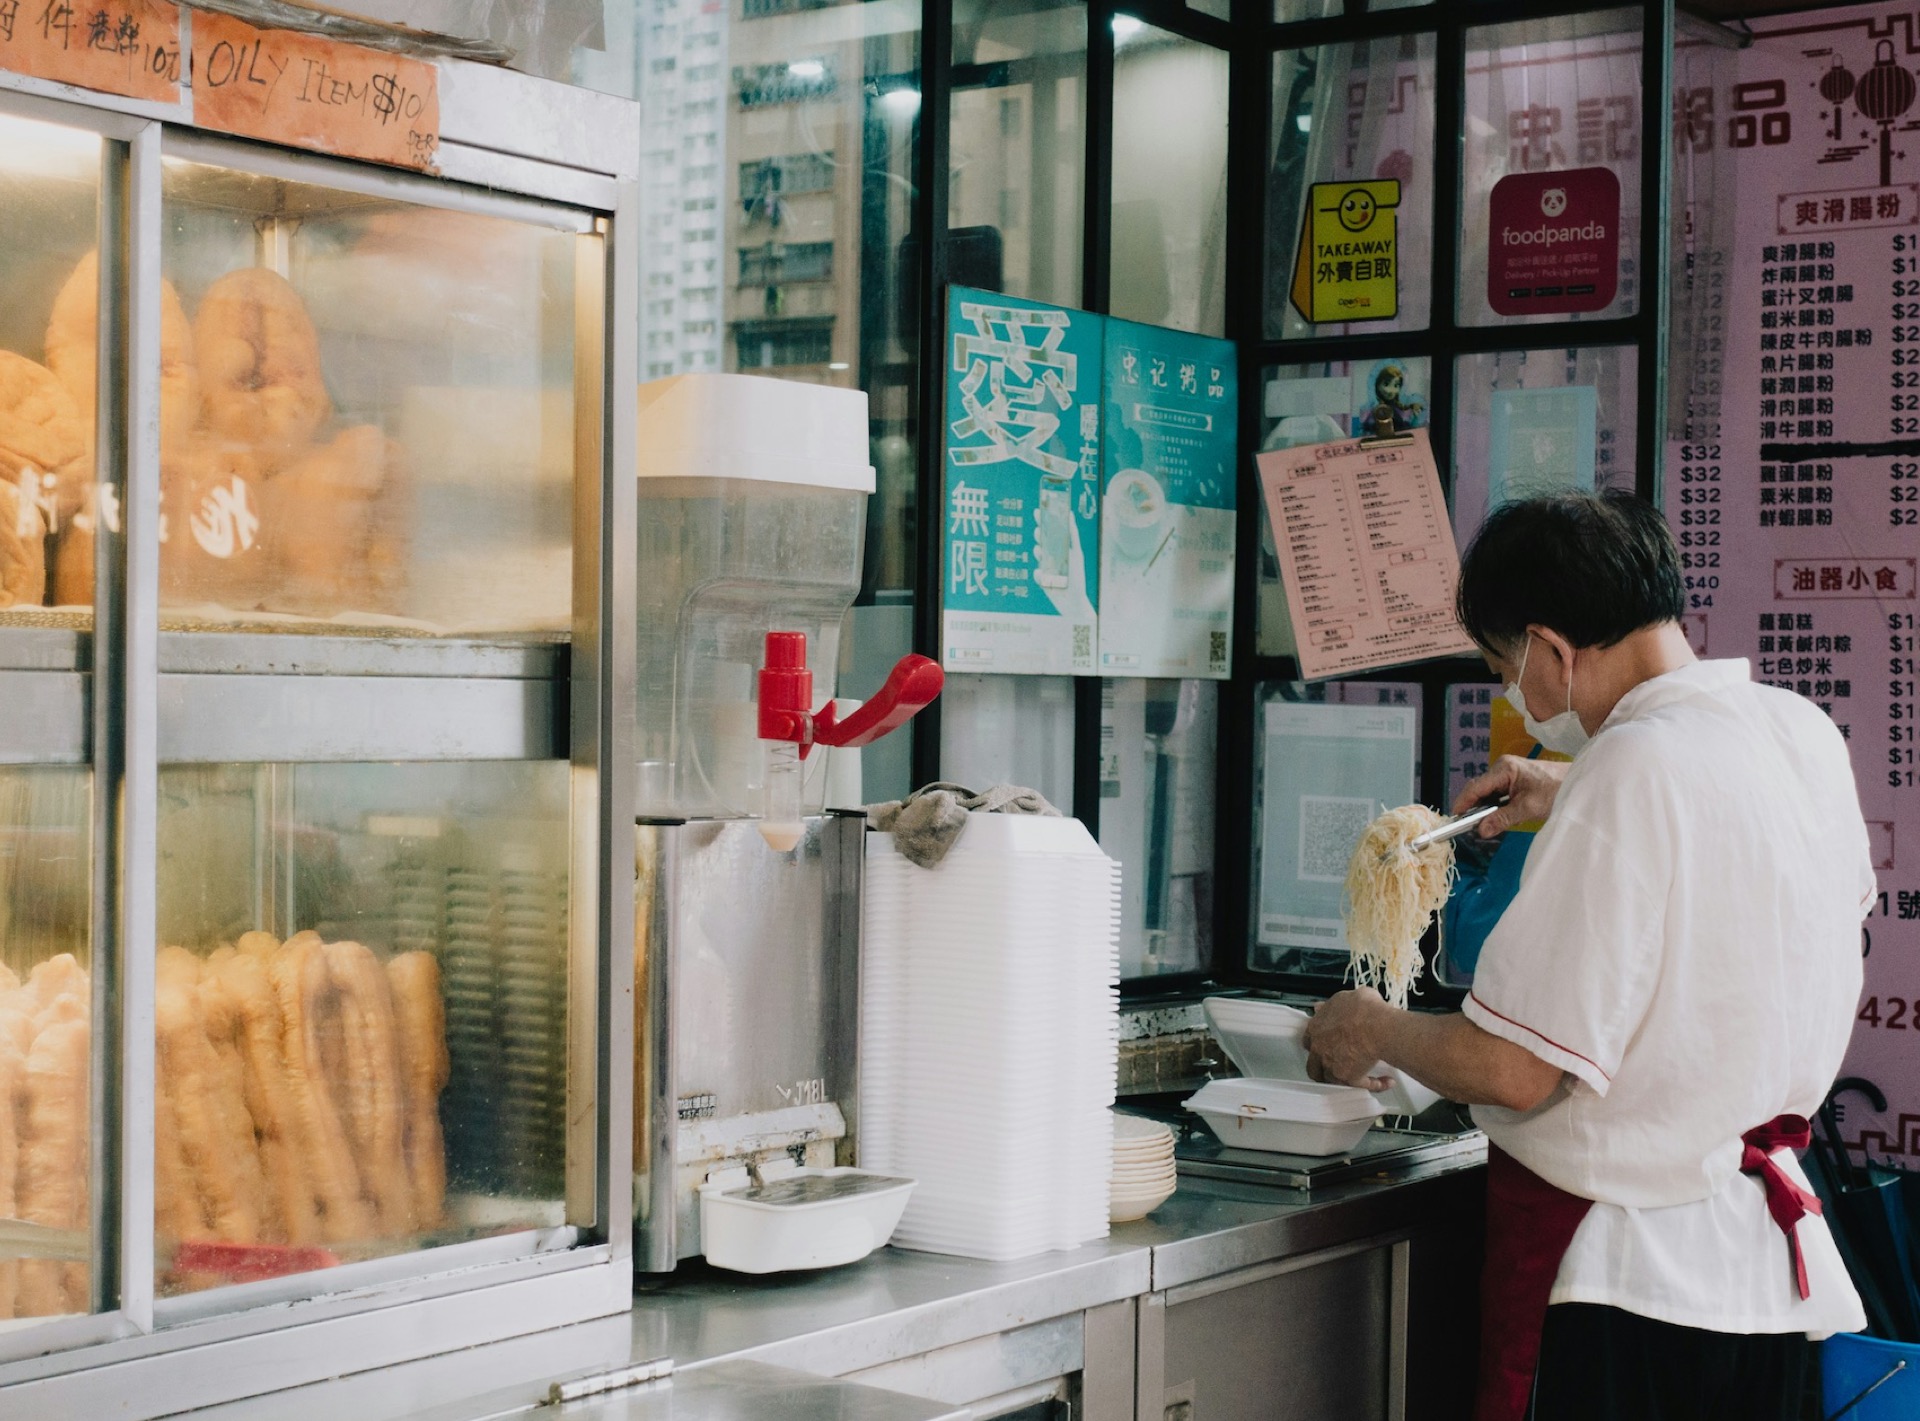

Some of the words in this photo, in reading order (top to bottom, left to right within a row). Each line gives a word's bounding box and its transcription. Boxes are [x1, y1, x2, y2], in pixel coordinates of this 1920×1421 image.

[206, 39, 290, 116] OILY
[1795, 193, 1901, 226] 爽滑腸粉
[1501, 220, 1605, 248] foodpanda
[1317, 240, 1390, 259] TAKEAWAY
[1762, 241, 1836, 264] 爽滑腸粉
[1316, 258, 1391, 284] 外賣自取
[1761, 263, 1835, 285] 炸兩腸粉
[1760, 307, 1835, 329] 蝦米腸粉
[1760, 328, 1873, 351] 陳皮牛肉腸粉
[1760, 352, 1835, 374] 魚片腸粉
[1121, 351, 1224, 397] 忠記粥品
[1760, 397, 1834, 418] 滑肉腸粉
[1760, 419, 1834, 440] 滑牛腸粉
[1681, 445, 1721, 462] $32
[1681, 467, 1721, 483] $32
[1681, 488, 1721, 505] $32
[1681, 509, 1721, 527] $32
[1759, 508, 1833, 527] 鮮蝦腸粉
[951, 480, 989, 596] 無限
[1681, 531, 1721, 547] $32
[1681, 552, 1721, 569] $32
[1685, 576, 1719, 590] $40
[1792, 565, 1898, 591] 油器小食
[1691, 594, 1713, 609] $4
[1759, 612, 1813, 632] 蘿蔔糕
[1889, 613, 1920, 630] $1
[1759, 634, 1851, 654] 蛋黃鹹肉粽
[1889, 635, 1920, 652] $1
[1759, 657, 1833, 676] 七色炒米
[1889, 658, 1920, 675] $1
[1889, 680, 1920, 697] $1
[1889, 703, 1920, 720] $1
[1889, 725, 1920, 742] $1
[1889, 747, 1920, 764] $1
[1889, 770, 1920, 787] $1
